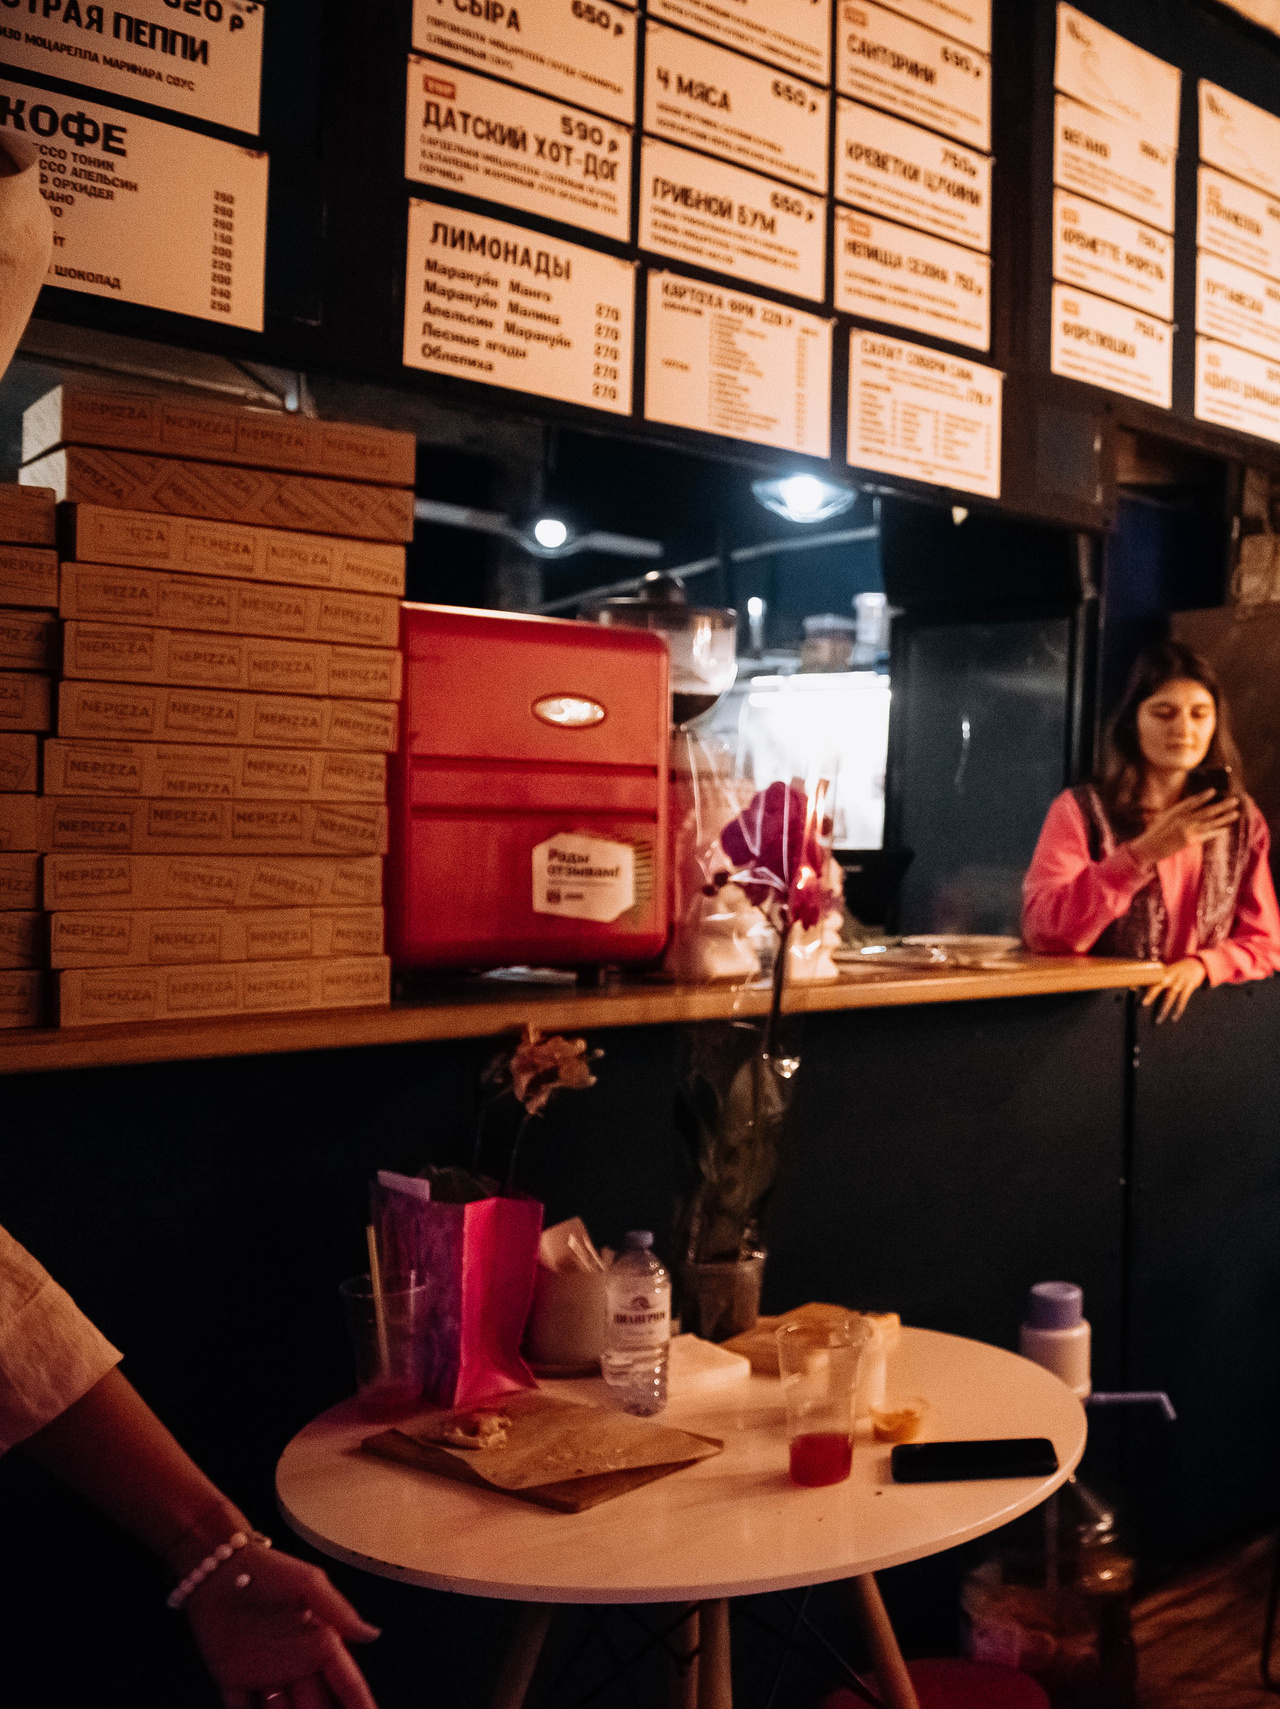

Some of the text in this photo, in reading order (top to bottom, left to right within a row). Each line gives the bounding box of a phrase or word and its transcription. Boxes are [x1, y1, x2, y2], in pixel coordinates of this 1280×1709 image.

[113, 11, 209, 66] ПЕППИ
[25, 32, 100, 63] МОЦАРЕЛЛА
[102, 54, 163, 82] МАРИНАРА
[165, 73, 196, 92] СОУС
[0, 95, 128, 158] КОФЕ
[423, 100, 528, 153] ДАТСКИЙ
[560, 114, 605, 147] 590
[71, 152, 115, 172] ТОНИК
[533, 133, 619, 182] ХОТ-ДОГ
[71, 167, 138, 192] АПЕЛЬСИН
[429, 220, 572, 281] ЛИМОНАДЫ
[54, 265, 121, 290] ШОКОЛАД
[508, 279, 552, 303] Манго
[506, 300, 561, 327] Малина
[420, 343, 495, 372] Облепиха
[165, 415, 232, 435] NEPIZZA
[79, 641, 148, 654] NEPIZZA
[172, 652, 237, 665] NEPIZZA
[251, 659, 313, 673] NEPIZZA
[331, 668, 389, 681] NEPIZZA
[81, 700, 150, 717] NEPIZZA
[171, 702, 235, 719] NEPIZZA
[258, 712, 319, 728] NEPIZZA
[333, 716, 390, 735] NEPIZZA
[69, 760, 138, 776] NEPIZZA
[247, 760, 308, 775] NEPIZZA
[166, 780, 231, 794] NEPIZZA
[153, 809, 219, 823] NEPIZZA
[236, 811, 299, 824] NEPIZZA
[57, 820, 128, 833] NEPIZZA
[318, 819, 376, 838] NEPIZZA
[58, 867, 128, 881] NEPIZZA
[172, 870, 234, 889] NEPIZZA
[257, 872, 316, 894] NEPIZZA
[58, 923, 127, 937] NEPIZZA
[154, 932, 218, 944] NEPIZZA
[84, 989, 153, 1001] NEPIZZA
[171, 980, 234, 994] NEPIZZA
